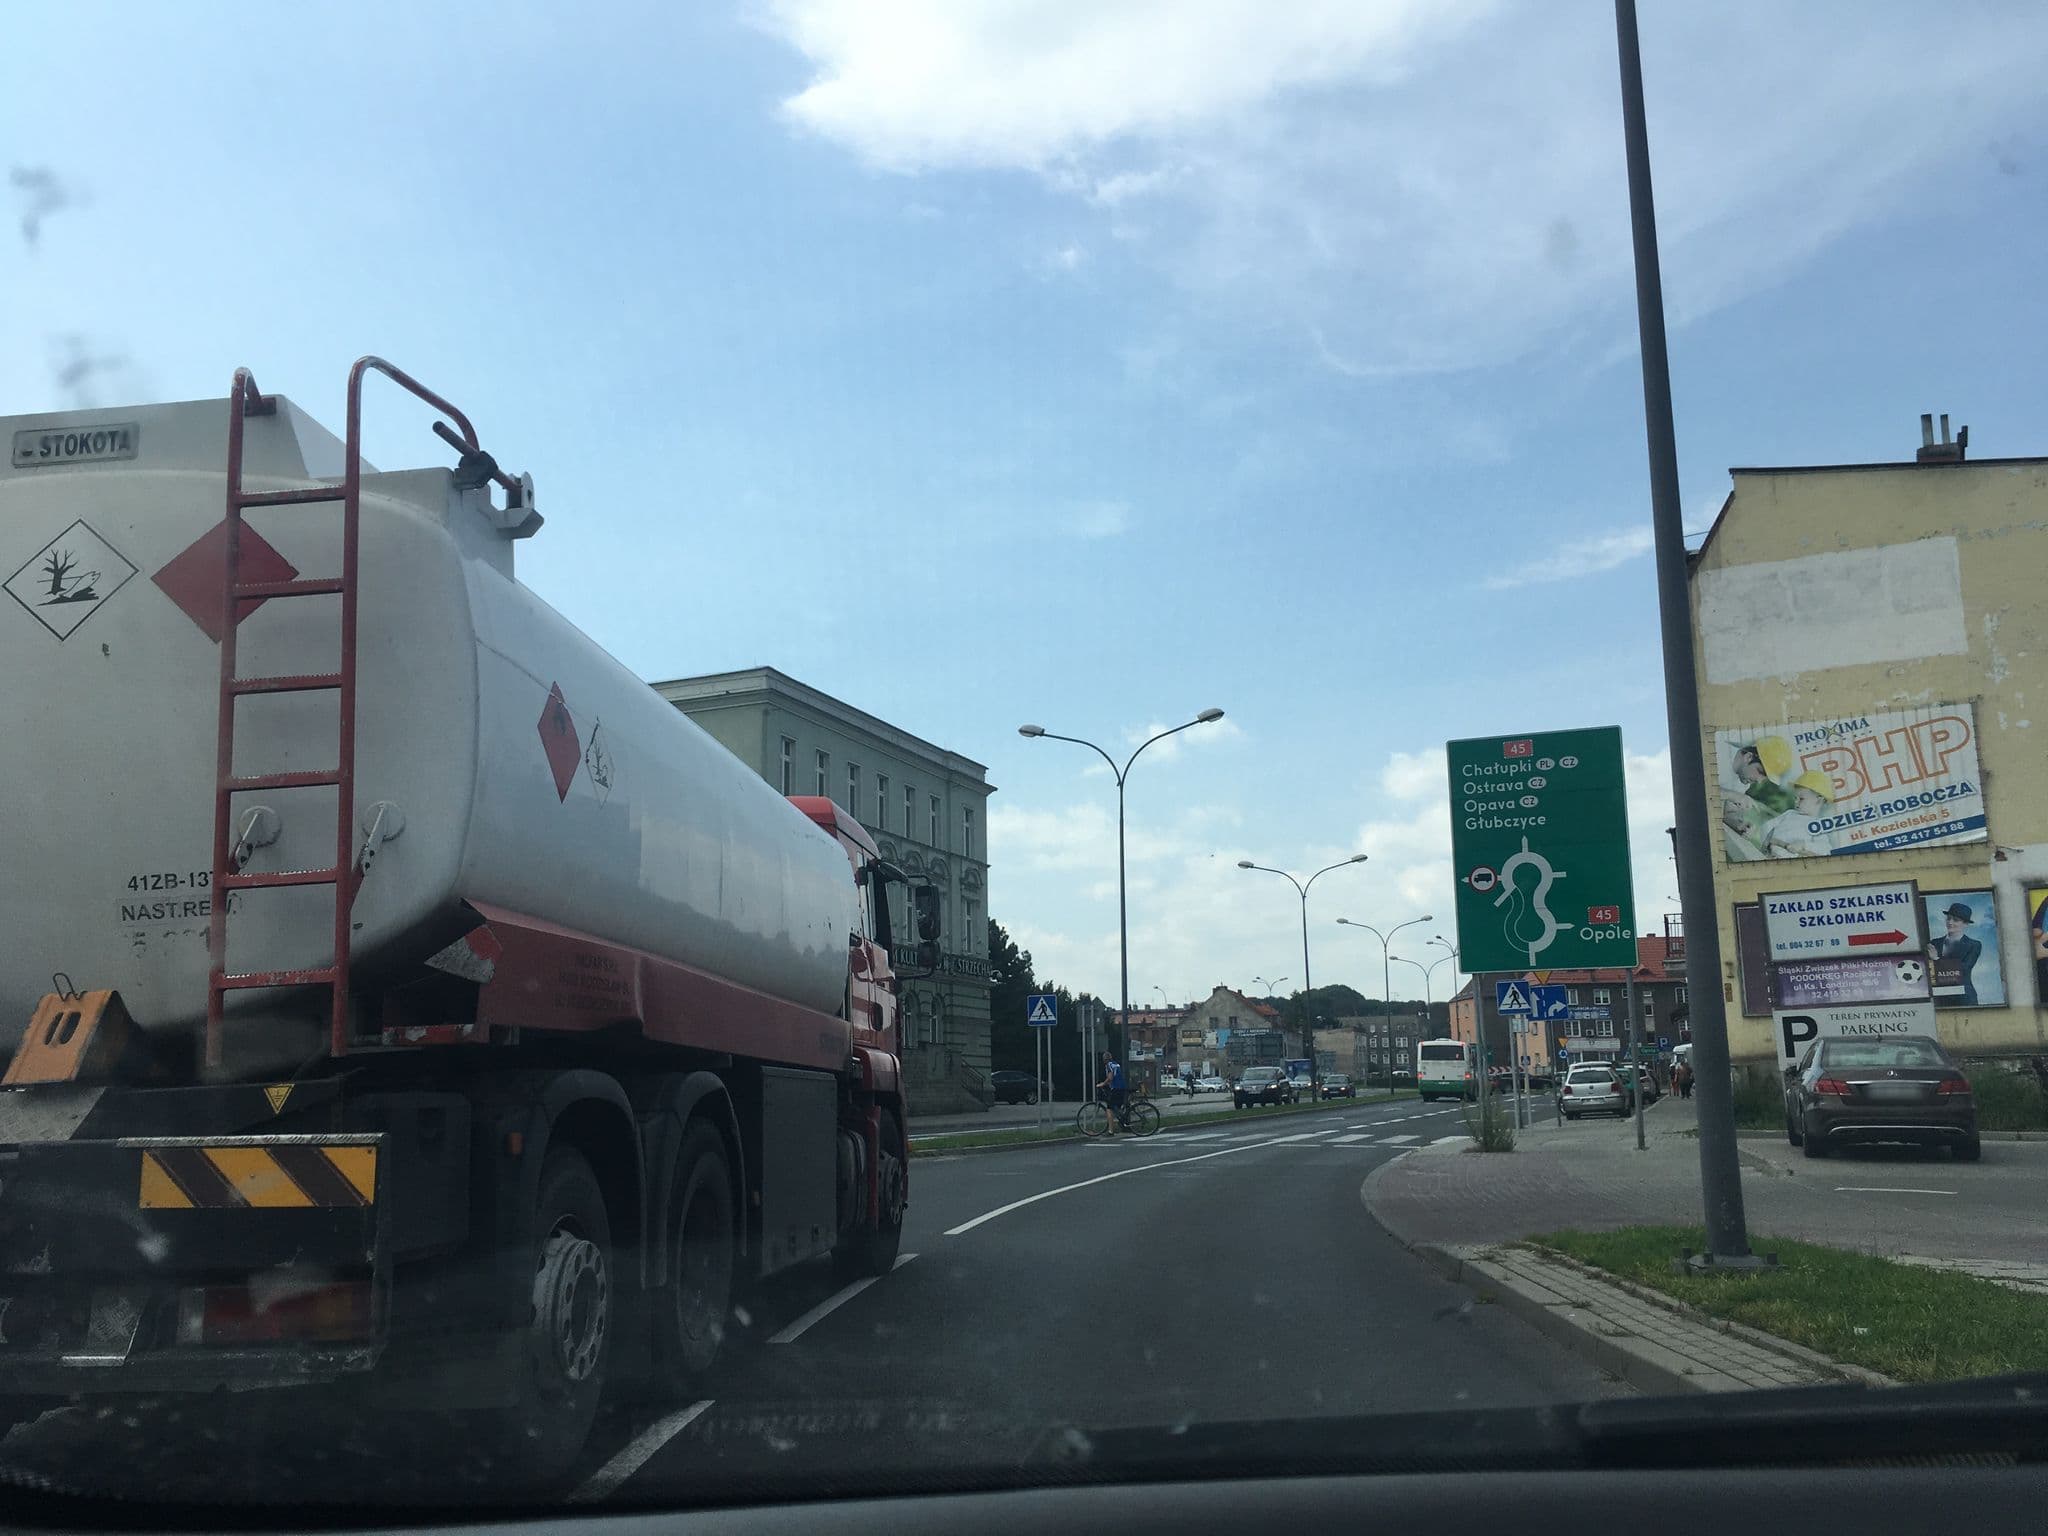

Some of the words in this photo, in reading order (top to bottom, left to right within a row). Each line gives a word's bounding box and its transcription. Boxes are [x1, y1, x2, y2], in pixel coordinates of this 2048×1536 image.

[40, 430, 130, 457] STOKOTA
[1794, 717, 1870, 745] PROXIMA
[1510, 743, 1526, 754] 45
[1462, 760, 1531, 777] Chałupki
[1539, 760, 1551, 768] PL
[1562, 758, 1575, 767] CZ
[1800, 716, 1970, 802] BHP
[1463, 781, 1523, 795] Ostrava
[1530, 778, 1543, 787] CZ
[1464, 799, 1515, 815] Opava
[1523, 797, 1535, 806] CZ
[1807, 804, 1877, 834] ODZIEŻ
[1880, 782, 1973, 816] ROBOCZA
[1465, 815, 1546, 830] Głubczyce
[1850, 831, 1868, 841] ul.
[1870, 813, 1937, 835] Kozielska
[1941, 808, 1950, 818] 5
[1874, 840, 1892, 849] tel.
[1894, 834, 1909, 844] 32
[1910, 829, 1930, 840] 417
[128, 871, 214, 891] 41ZB-13
[1769, 900, 1824, 914] ZAKŁAD
[1829, 892, 1909, 909] SZKLARSKI
[1595, 909, 1612, 920] 45
[1799, 911, 1886, 927] SZKŁOMARK
[1830, 1012, 1861, 1021] TEREN
[1864, 1010, 1917, 1020] PRYWATNY
[1782, 1015, 1818, 1058] P
[1841, 1022, 1908, 1035] PARKING
